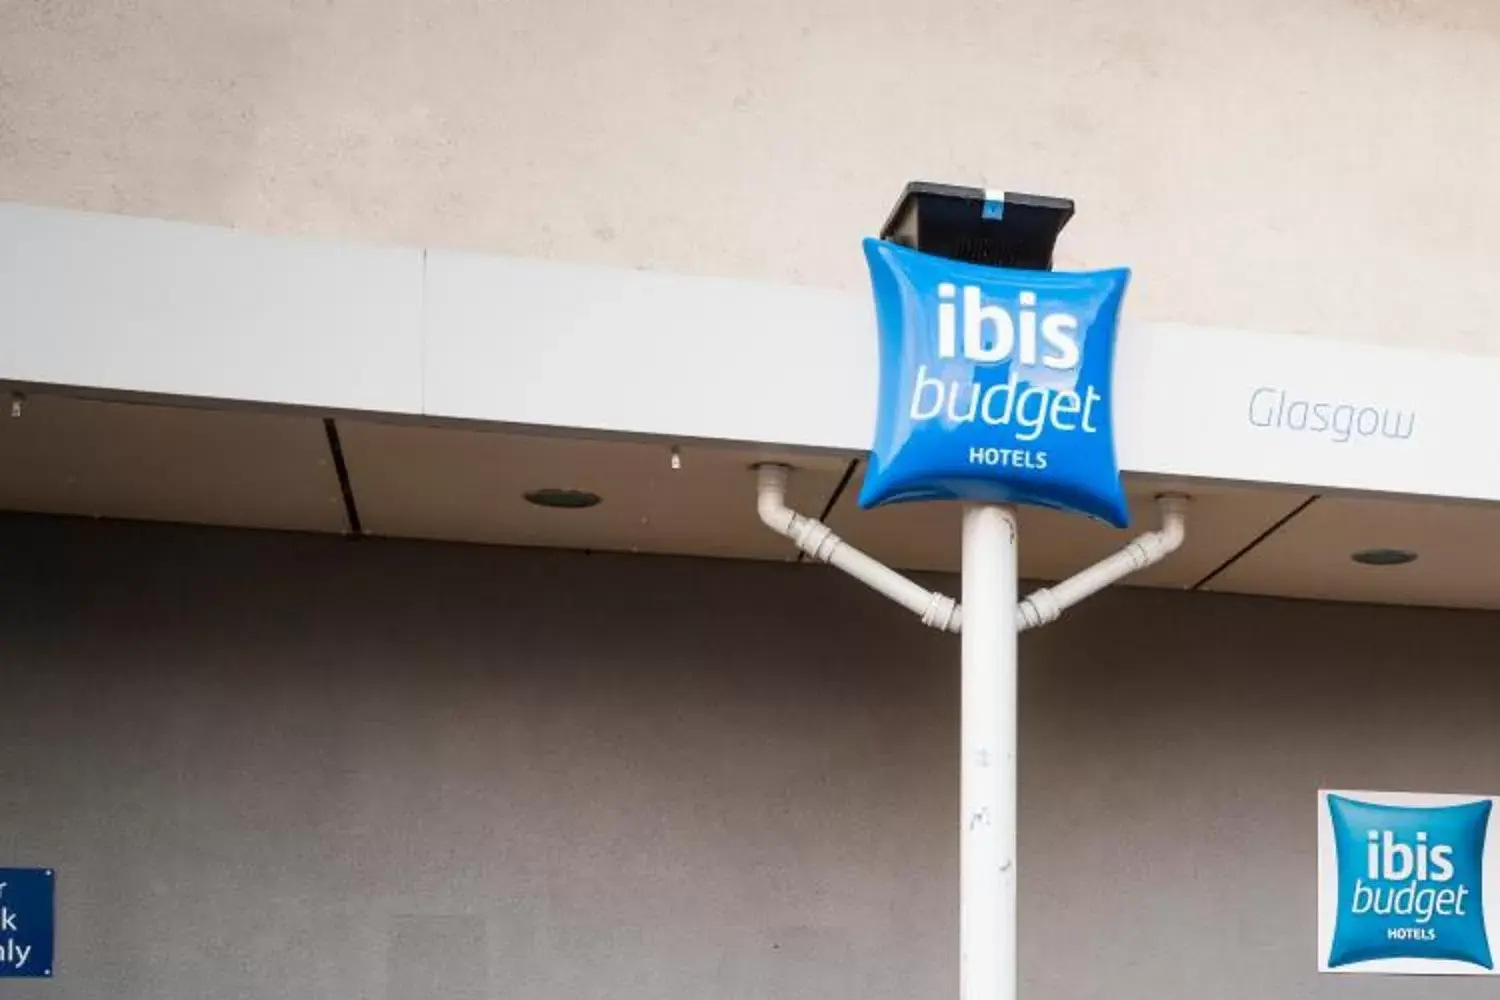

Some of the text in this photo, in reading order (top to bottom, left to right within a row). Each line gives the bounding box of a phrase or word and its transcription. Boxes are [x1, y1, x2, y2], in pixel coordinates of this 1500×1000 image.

[937, 282, 1080, 370] ibis
[909, 364, 1101, 442] budget
[1248, 386, 1416, 443] Glasgow
[968, 446, 1048, 470] HOTELS
[1366, 829, 1456, 882] ibis
[1351, 878, 1470, 924] budget
[1387, 926, 1437, 941] HOTELS
